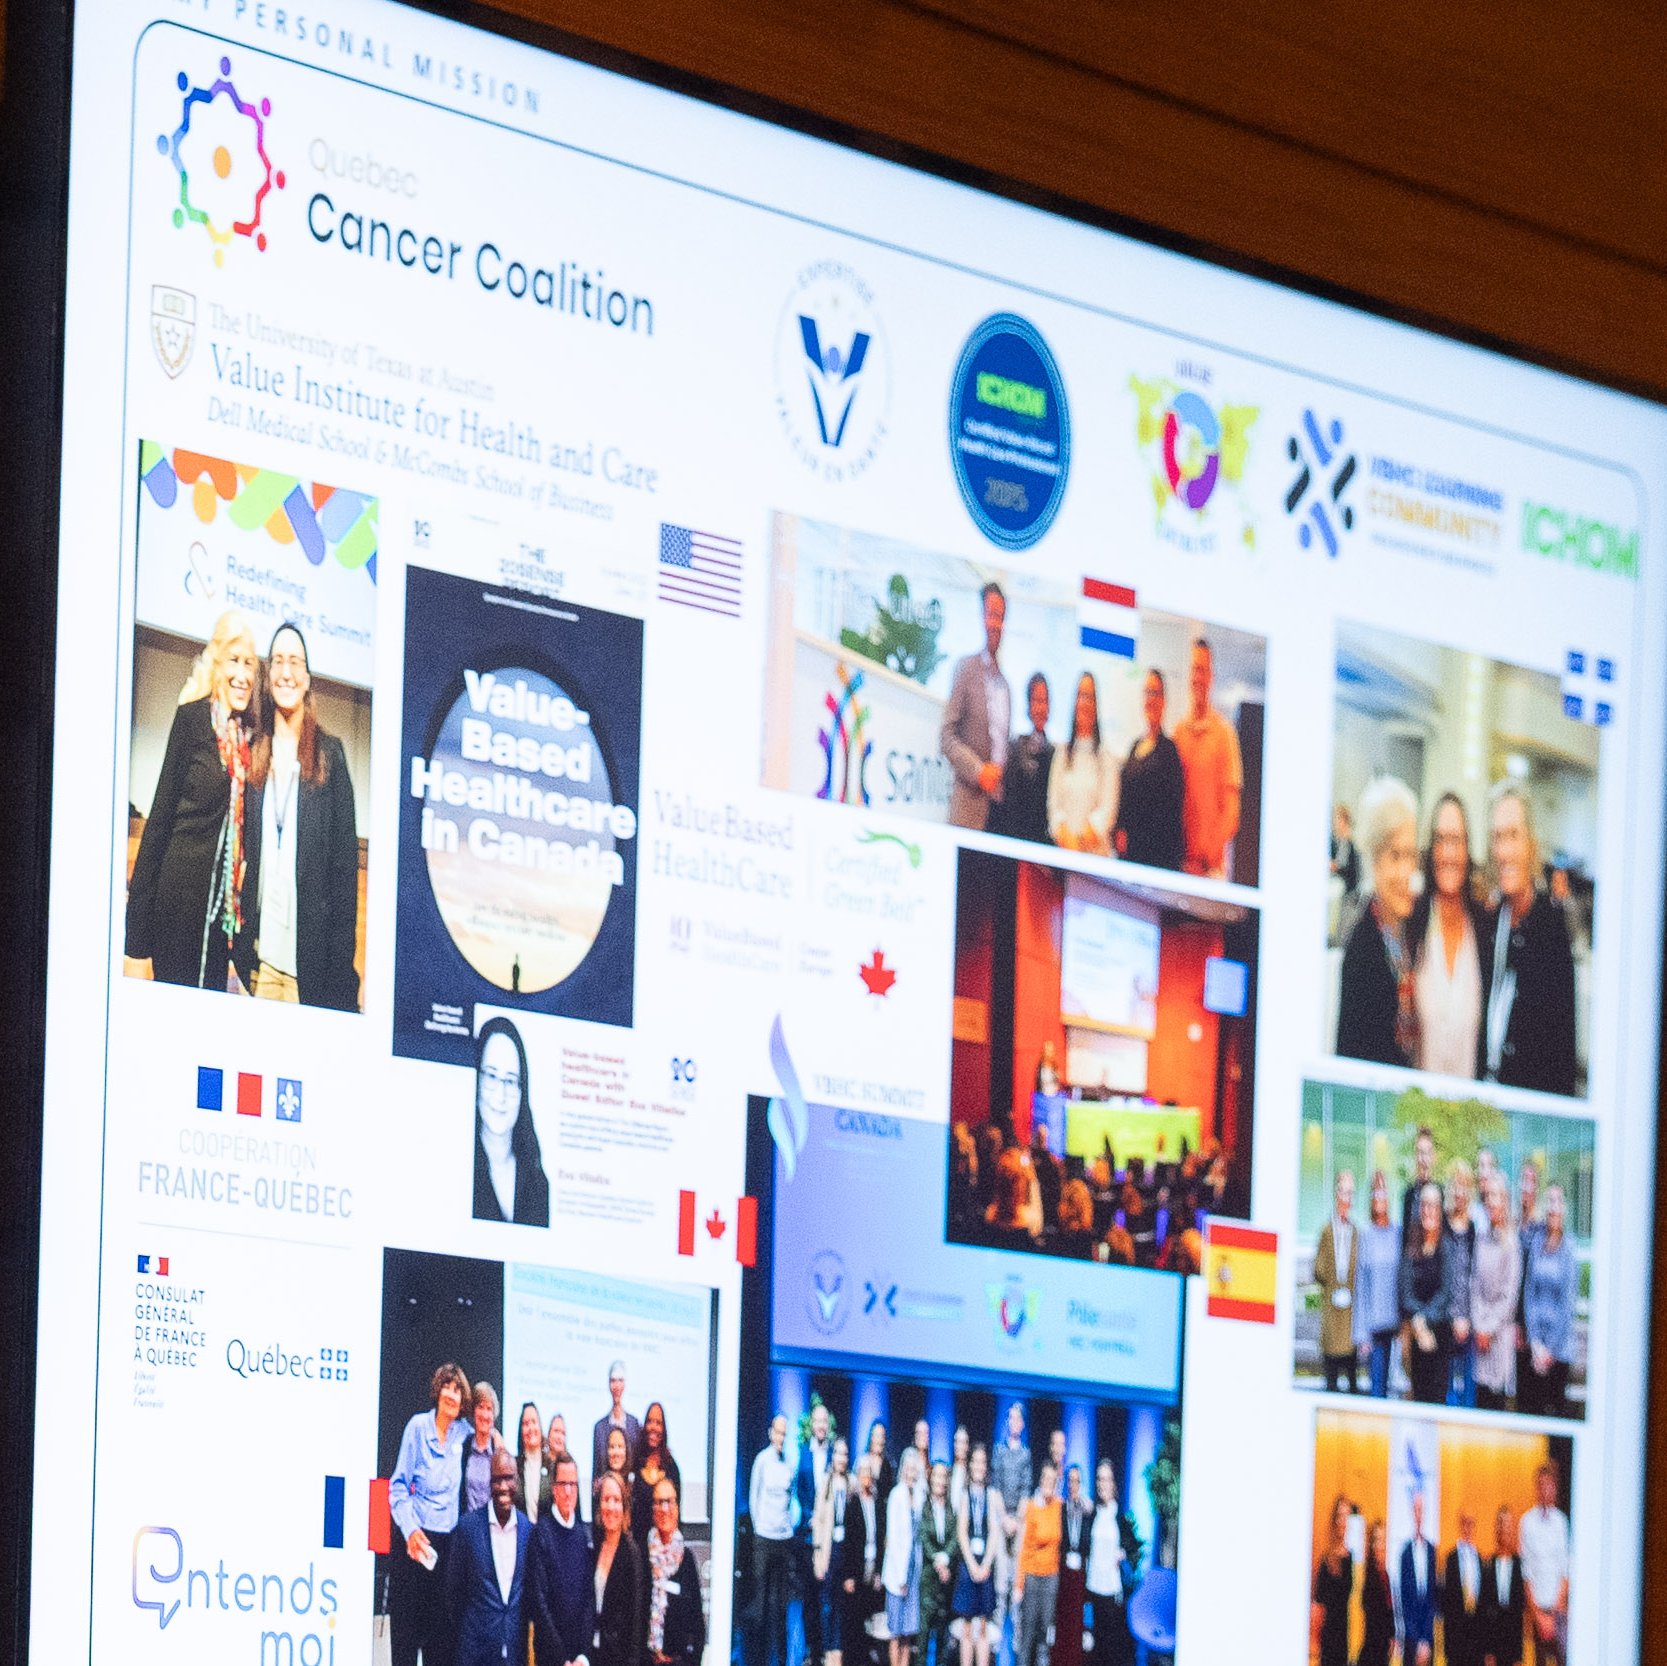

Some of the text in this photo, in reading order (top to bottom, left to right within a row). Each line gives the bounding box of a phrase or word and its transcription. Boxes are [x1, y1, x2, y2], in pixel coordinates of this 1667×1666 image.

[235, 0, 541, 114] PERSONAL MISSION
[307, 192, 655, 338] Cancer Coalition
[208, 302, 496, 403] The University of Texas at Austin
[210, 341, 659, 494] Value Institute for Health and Care
[206, 396, 615, 522] Dell Medical School & McCombs School of Business
[1520, 499, 1640, 582] ICHOM
[225, 553, 307, 605] Redefining
[224, 582, 372, 646] Health Care Summit
[463, 669, 590, 731] Value-
[461, 718, 591, 784] Based
[411, 755, 637, 841] Healthcare
[652, 788, 795, 852] ValueBased
[421, 807, 624, 887] in Canada
[651, 838, 794, 901] HealthCare
[177, 1127, 317, 1171] COOPÉRATION
[137, 1161, 354, 1219] FRANCE-QUÉBEC
[134, 1302, 195, 1326] GÉNÉRAL
[135, 1282, 206, 1305] CONSULAT
[133, 1343, 198, 1368] À QUÉBEC
[134, 1325, 208, 1348] DE FRANCE
[225, 1338, 316, 1380] Québec
